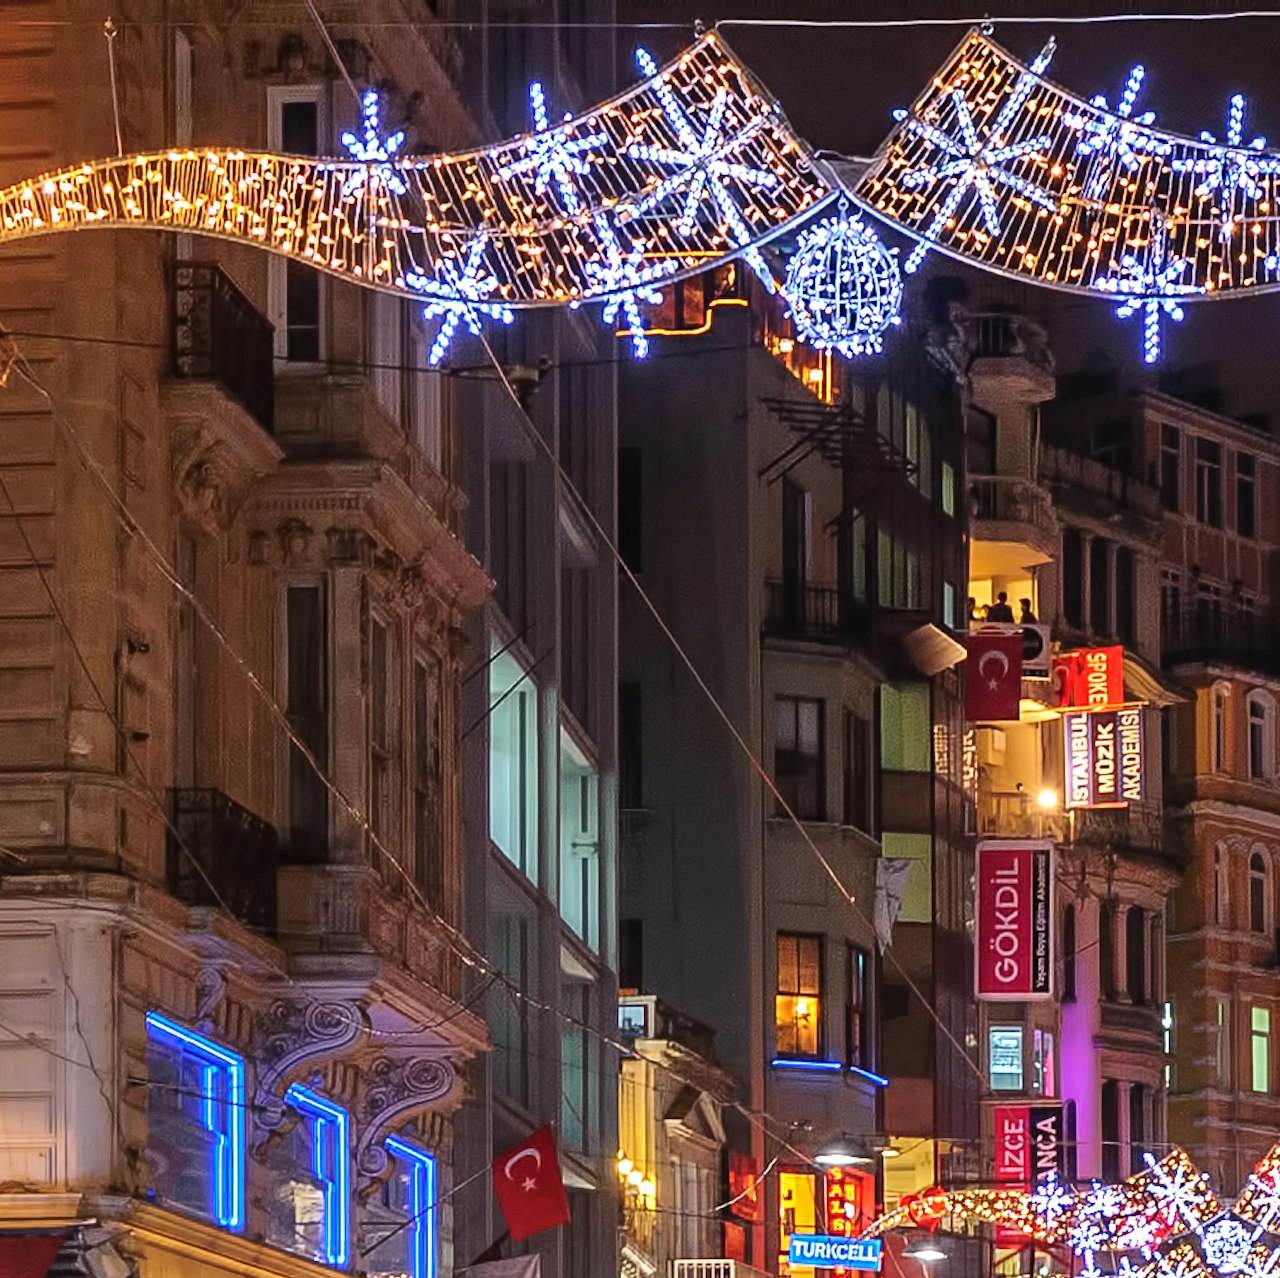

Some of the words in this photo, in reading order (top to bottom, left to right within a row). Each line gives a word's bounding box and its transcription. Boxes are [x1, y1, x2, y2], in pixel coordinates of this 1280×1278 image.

[1095, 723, 1115, 793] MÜZİK
[1117, 709, 1141, 800] AKADEMİSİ
[990, 857, 1019, 983] GÖKDİL
[792, 1240, 878, 1262] TURKCELL
